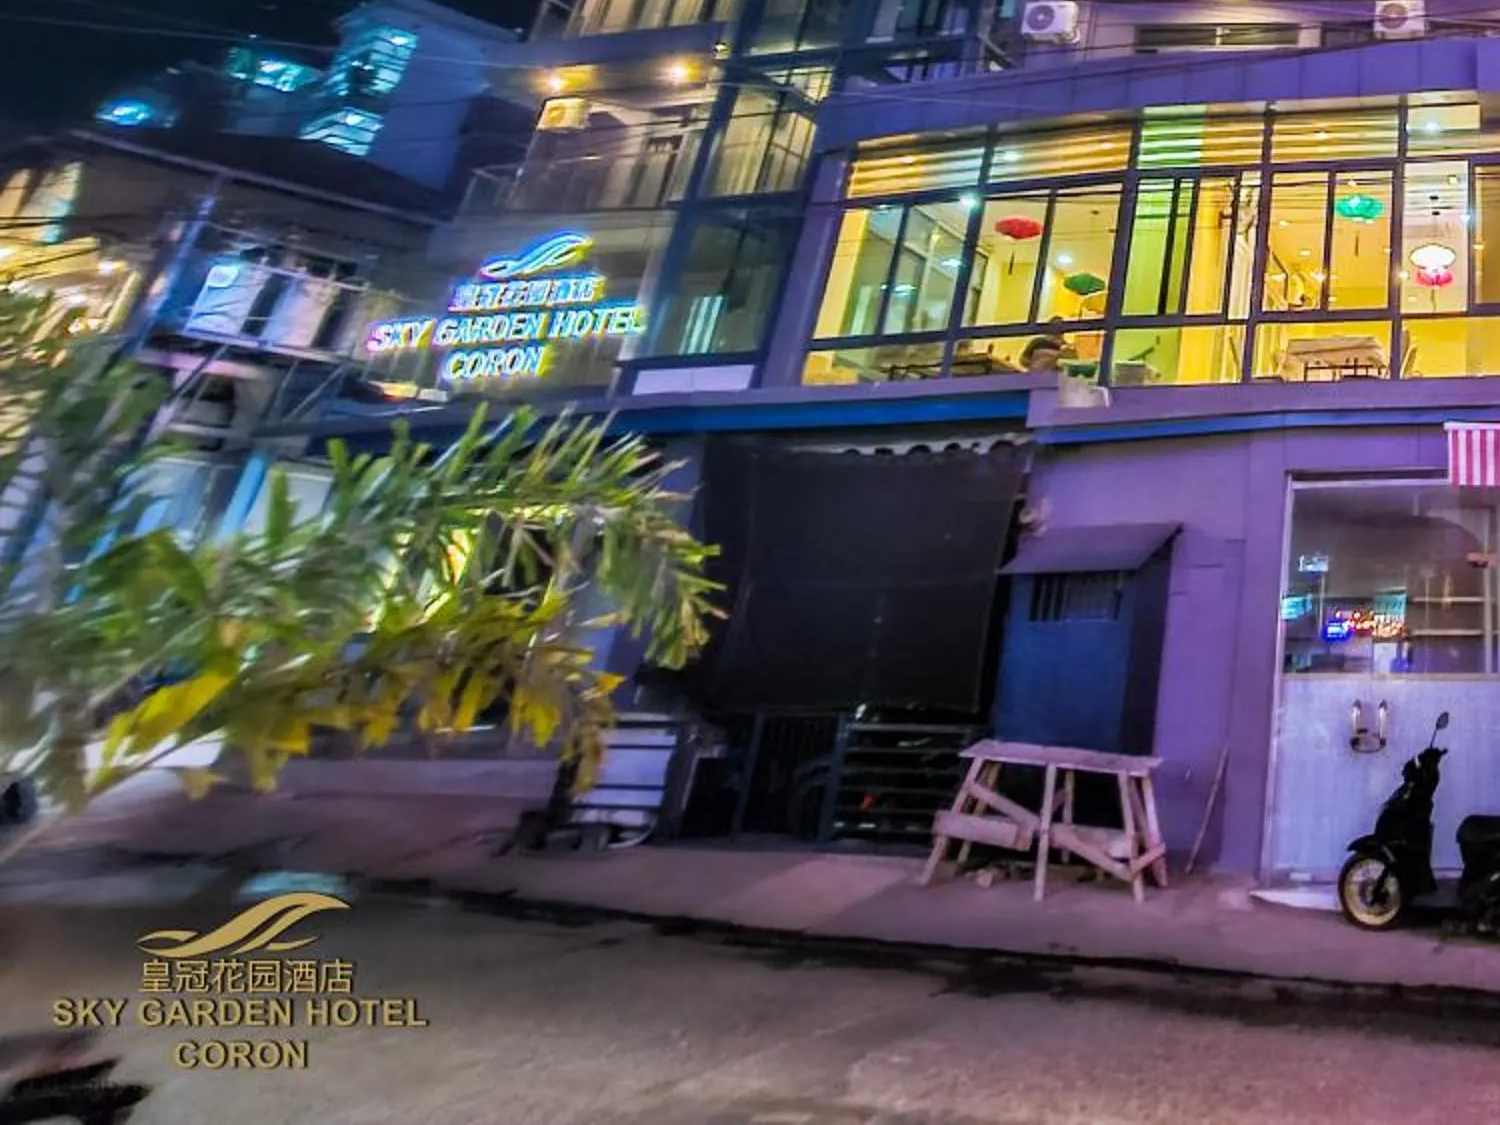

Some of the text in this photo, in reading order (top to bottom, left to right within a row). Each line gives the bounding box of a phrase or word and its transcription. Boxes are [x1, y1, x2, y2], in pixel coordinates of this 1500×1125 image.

[368, 305, 647, 352] SKY GARDEN HOTEL
[444, 344, 553, 379] CORON
